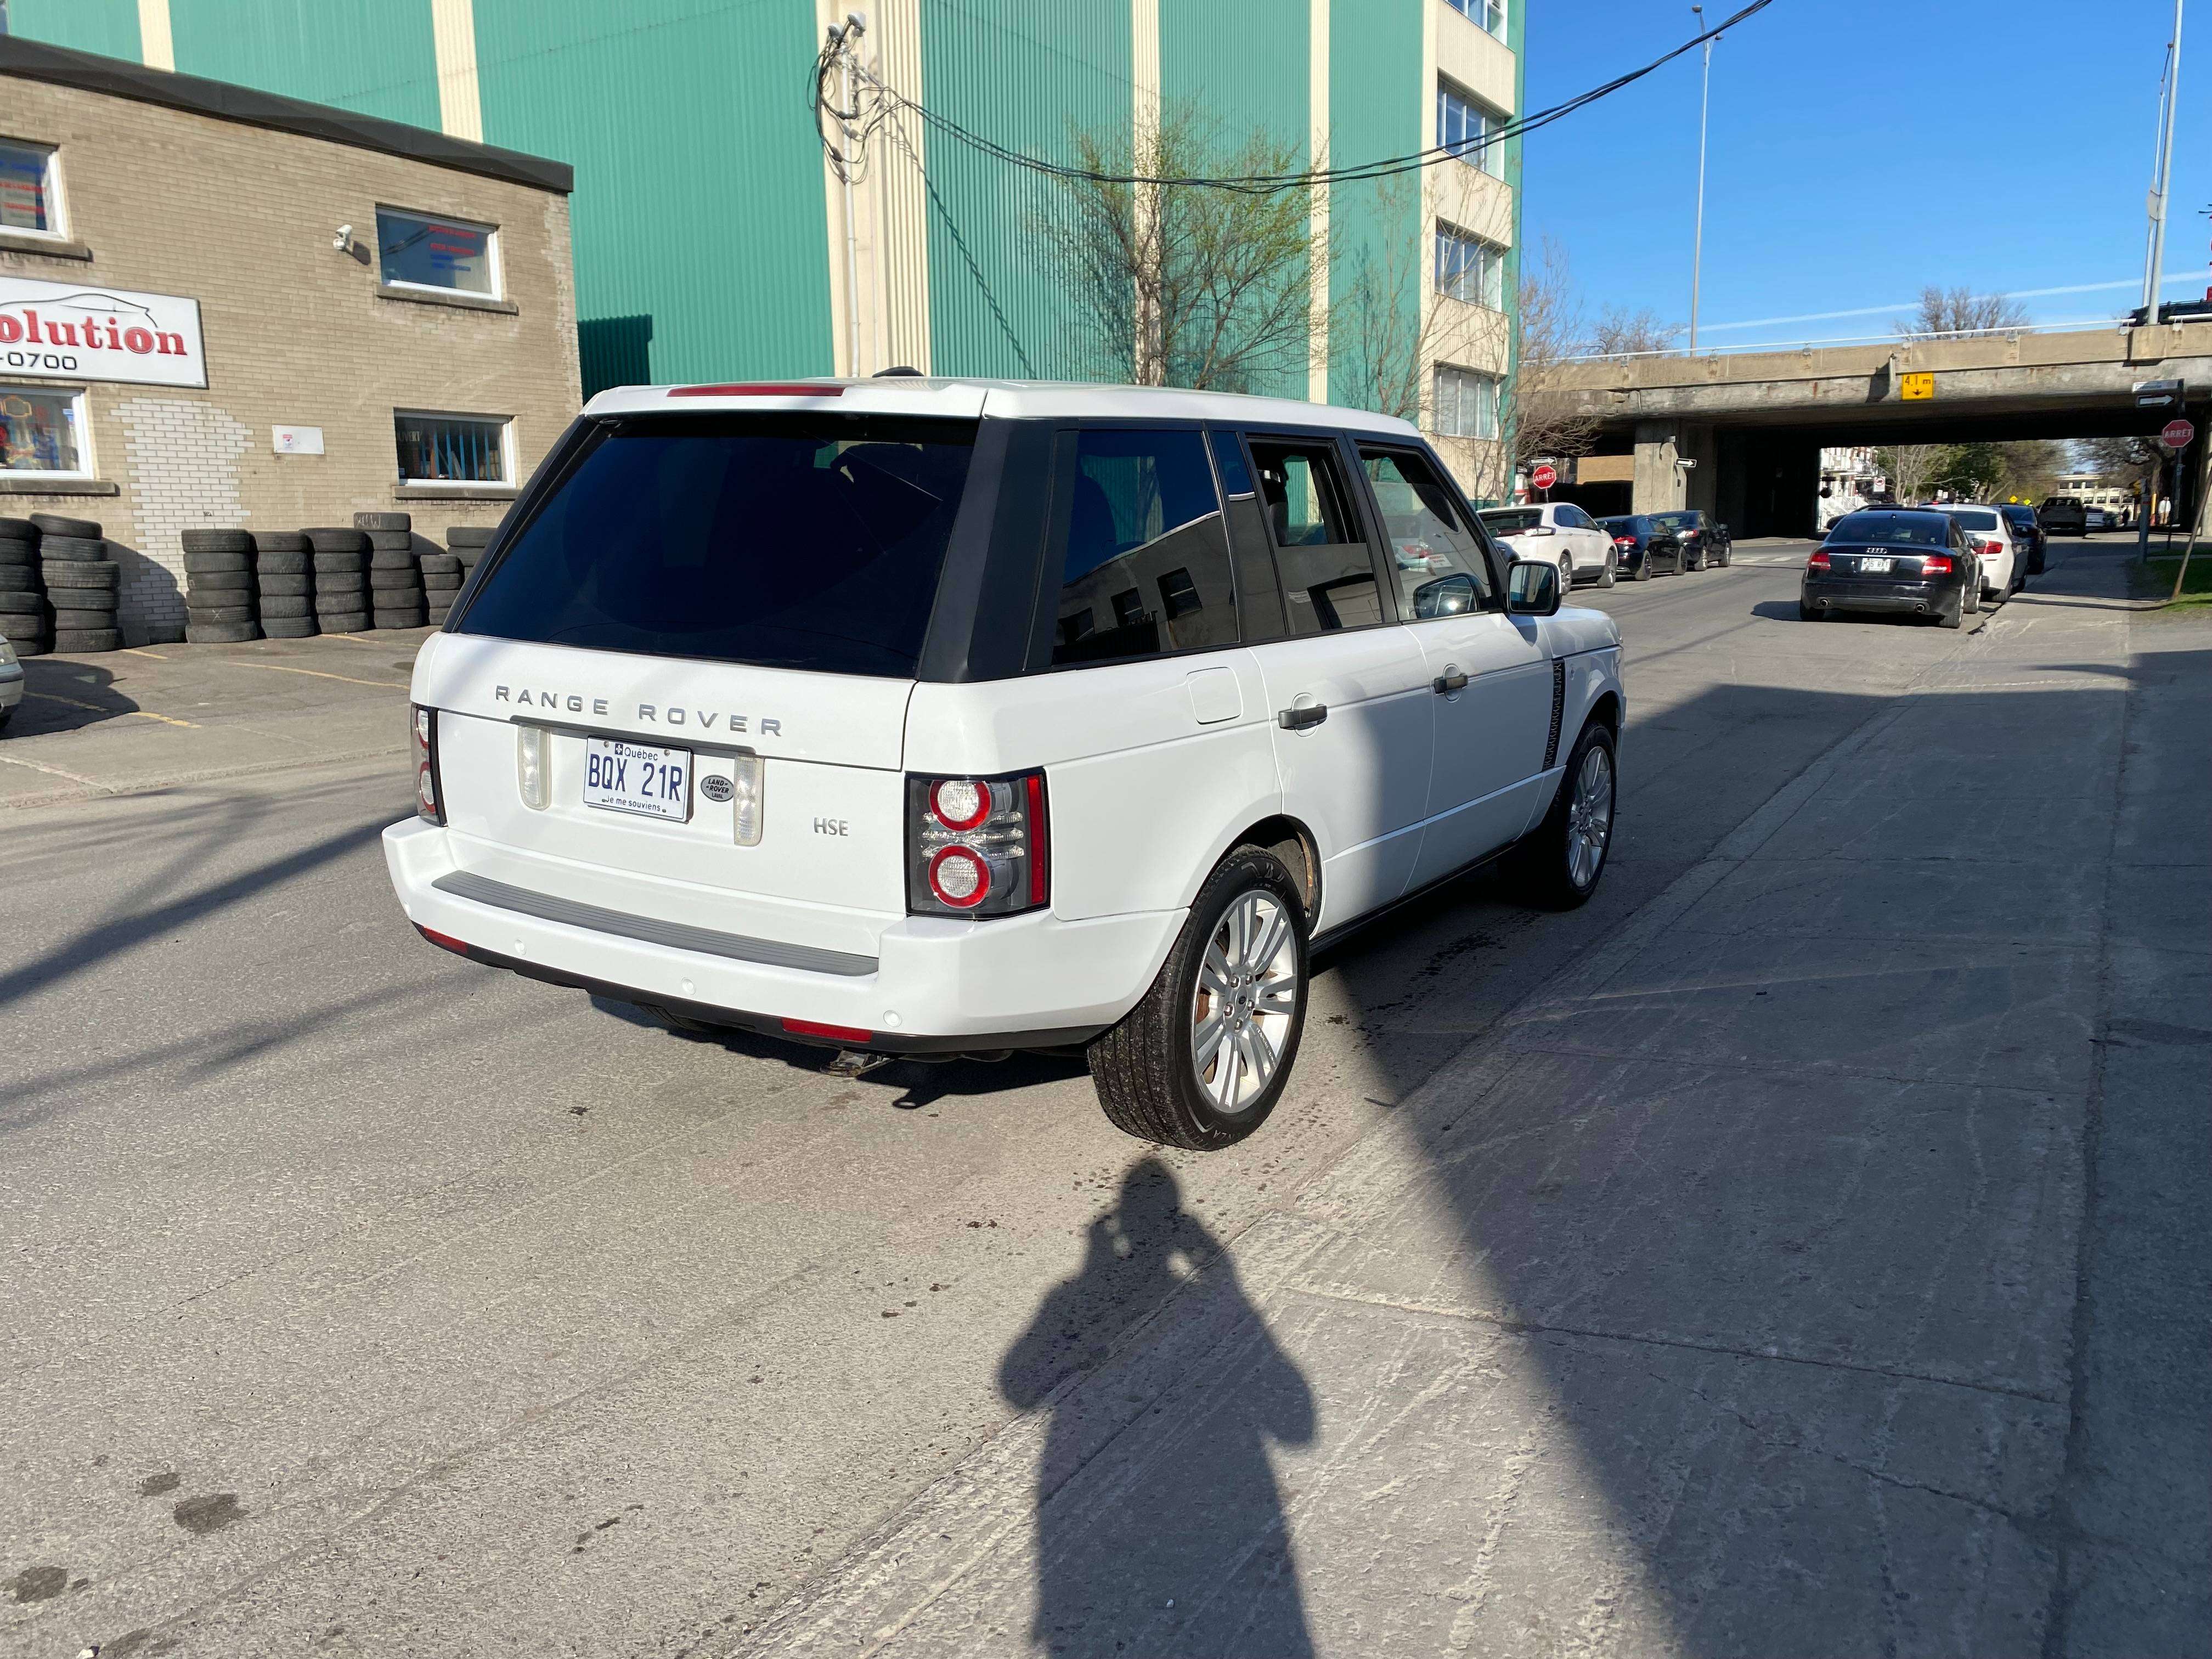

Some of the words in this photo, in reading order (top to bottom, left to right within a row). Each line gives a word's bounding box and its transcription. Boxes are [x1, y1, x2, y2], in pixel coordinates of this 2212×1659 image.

[1905, 375, 1918, 386] 4.1
[2164, 428, 2192, 438] ARRÊT
[1534, 471, 1554, 482] ARRÊT
[495, 685, 609, 715] RANGE
[638, 703, 782, 737] ROVER
[624, 747, 658, 761] Québec
[588, 753, 628, 792] BQX
[641, 762, 682, 802] 21R
[605, 795, 614, 804] Je
[628, 800, 661, 811] souviens
[814, 817, 849, 837] HSE
